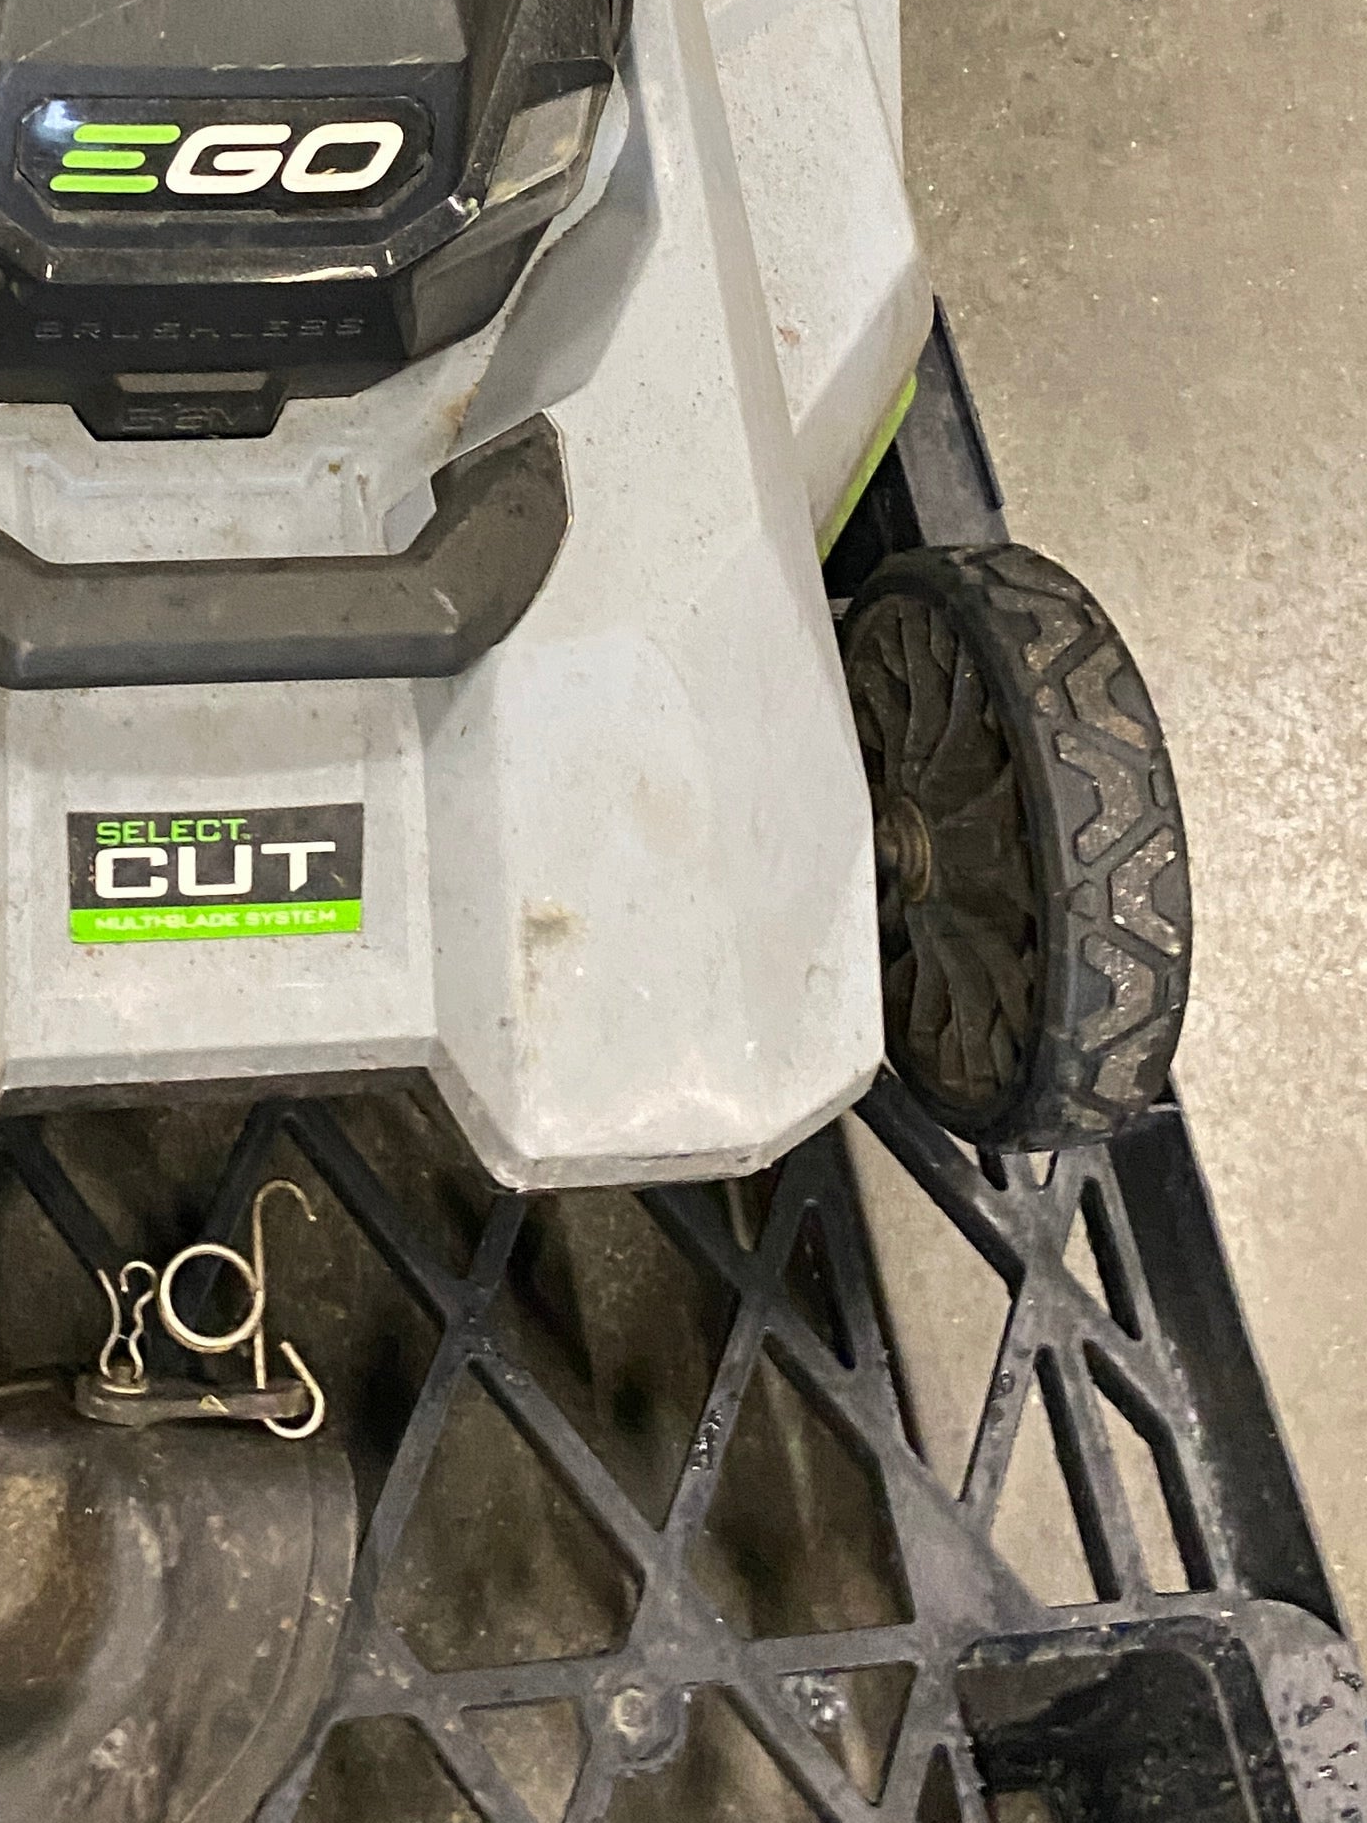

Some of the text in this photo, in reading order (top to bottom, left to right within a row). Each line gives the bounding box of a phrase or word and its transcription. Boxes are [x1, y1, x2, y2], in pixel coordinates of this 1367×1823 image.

[49, 121, 404, 194] EGO
[95, 818, 248, 845] SELECT
[94, 841, 336, 898] CUT
[245, 909, 336, 926] SYSTEM
